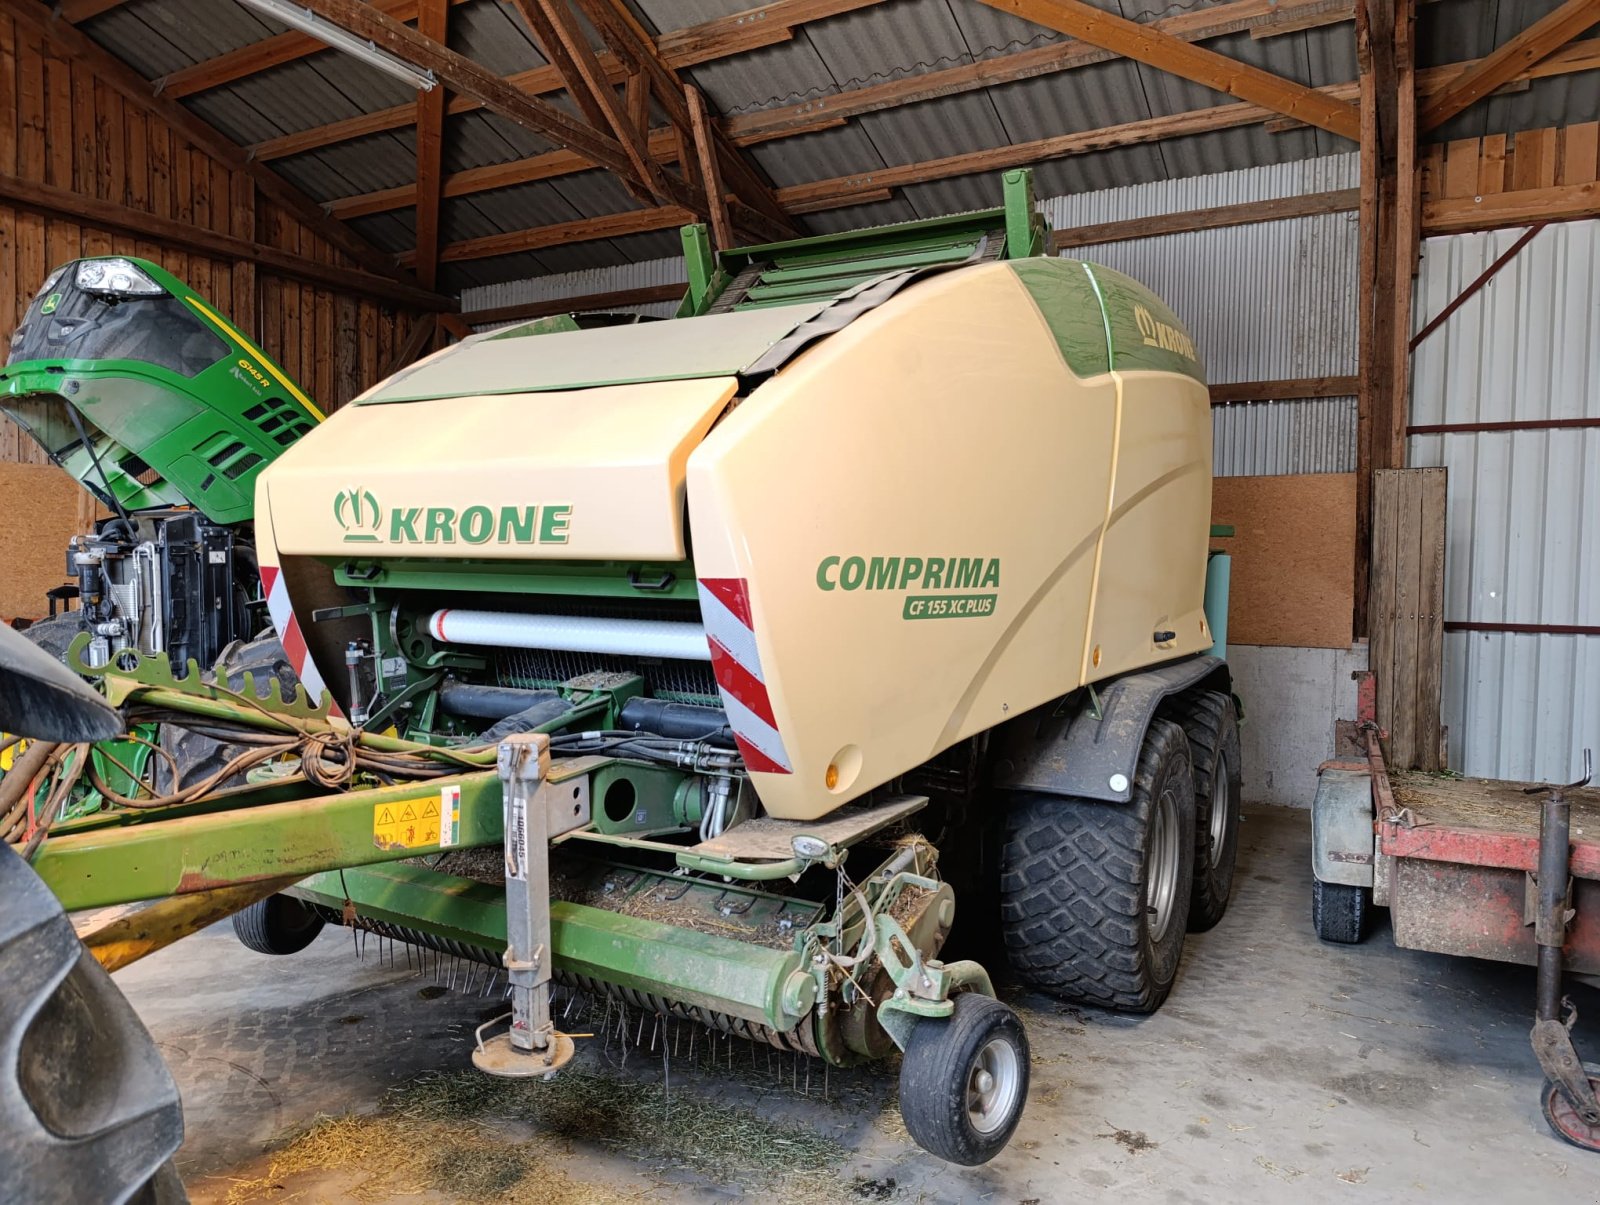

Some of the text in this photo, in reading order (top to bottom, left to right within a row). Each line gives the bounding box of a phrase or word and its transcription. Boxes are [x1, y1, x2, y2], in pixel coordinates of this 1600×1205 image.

[390, 505, 573, 544] KRONE
[816, 555, 1000, 591] COMPRIMA
[909, 598, 992, 616] CF 155 XC PLUS
